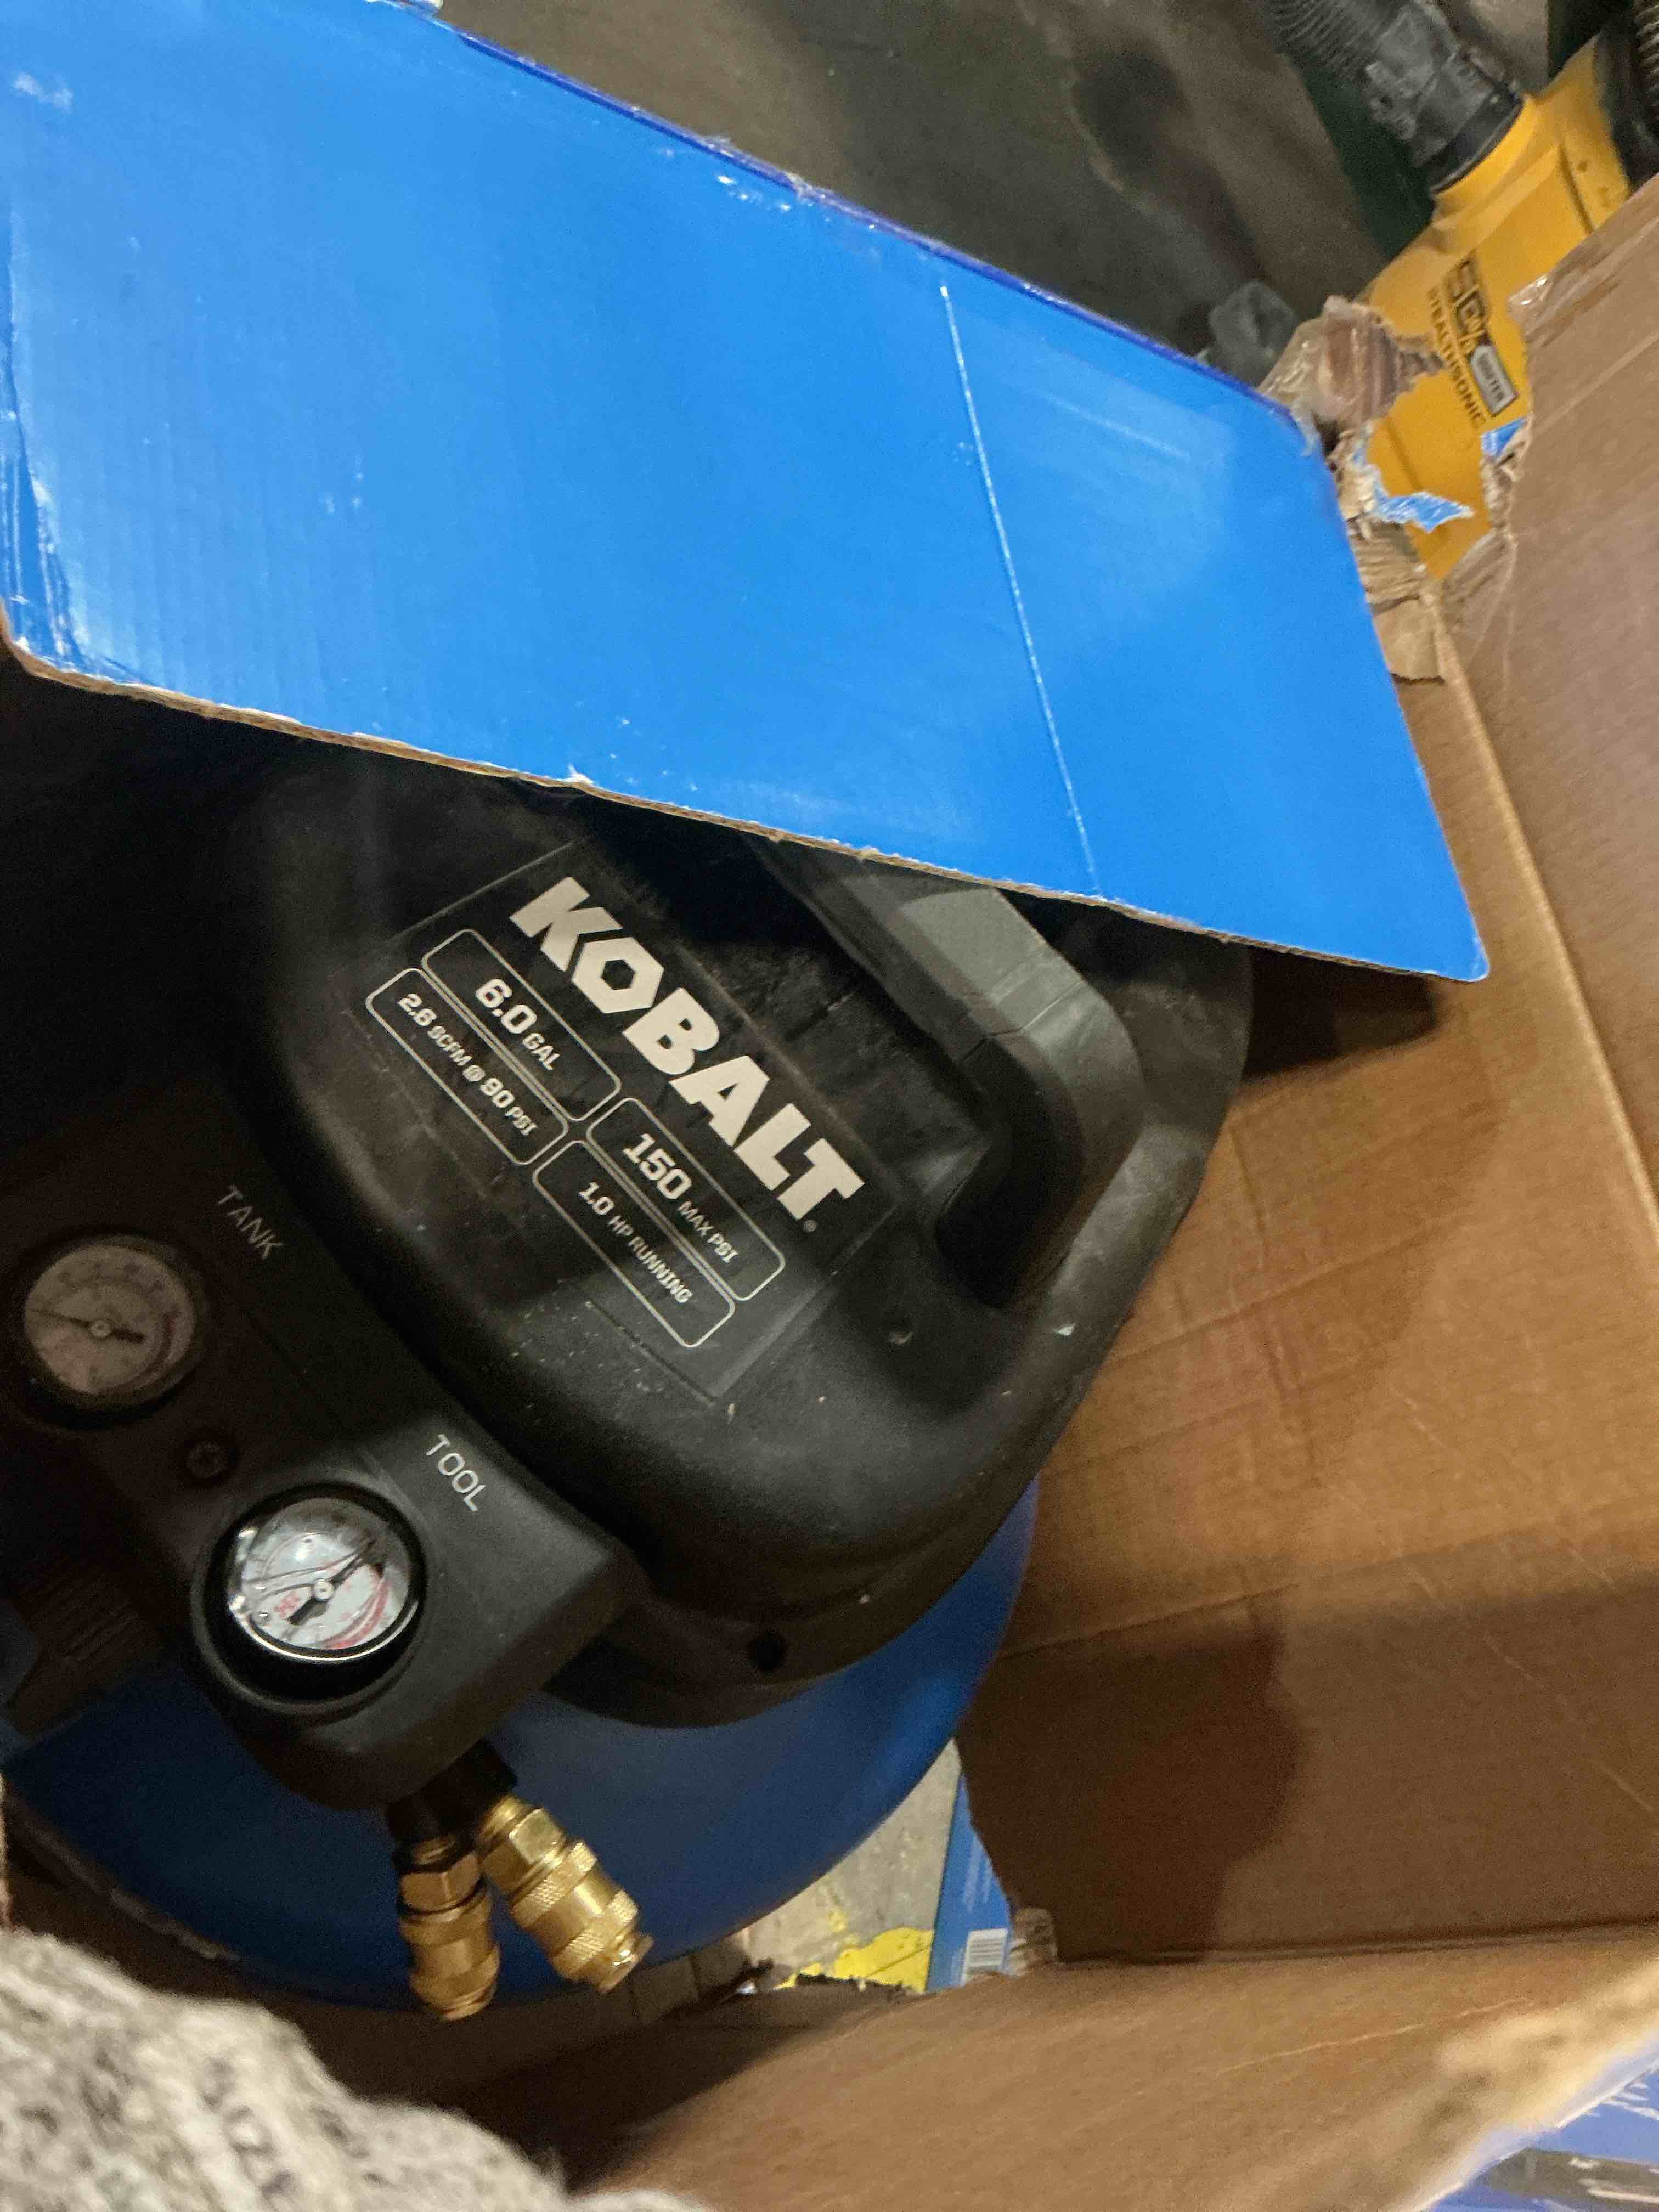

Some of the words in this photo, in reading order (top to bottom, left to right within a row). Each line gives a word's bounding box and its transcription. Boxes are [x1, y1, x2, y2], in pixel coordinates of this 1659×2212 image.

[475, 979, 537, 1034] 6.0
[522, 1032, 560, 1070] GAL
[509, 877, 865, 1220] KOBALT
[427, 1025, 472, 1066] SCFM
[480, 1078, 515, 1108] 90
[505, 1107, 537, 1136] PSI
[218, 1184, 283, 1260] TANK
[579, 1182, 614, 1215] 1.0
[608, 1216, 633, 1236] HP
[628, 1236, 693, 1303] RUNNING
[623, 1133, 692, 1199] 150
[678, 1201, 713, 1237] MAX
[707, 1233, 738, 1263] PSI
[426, 1434, 487, 1512] TOOL
